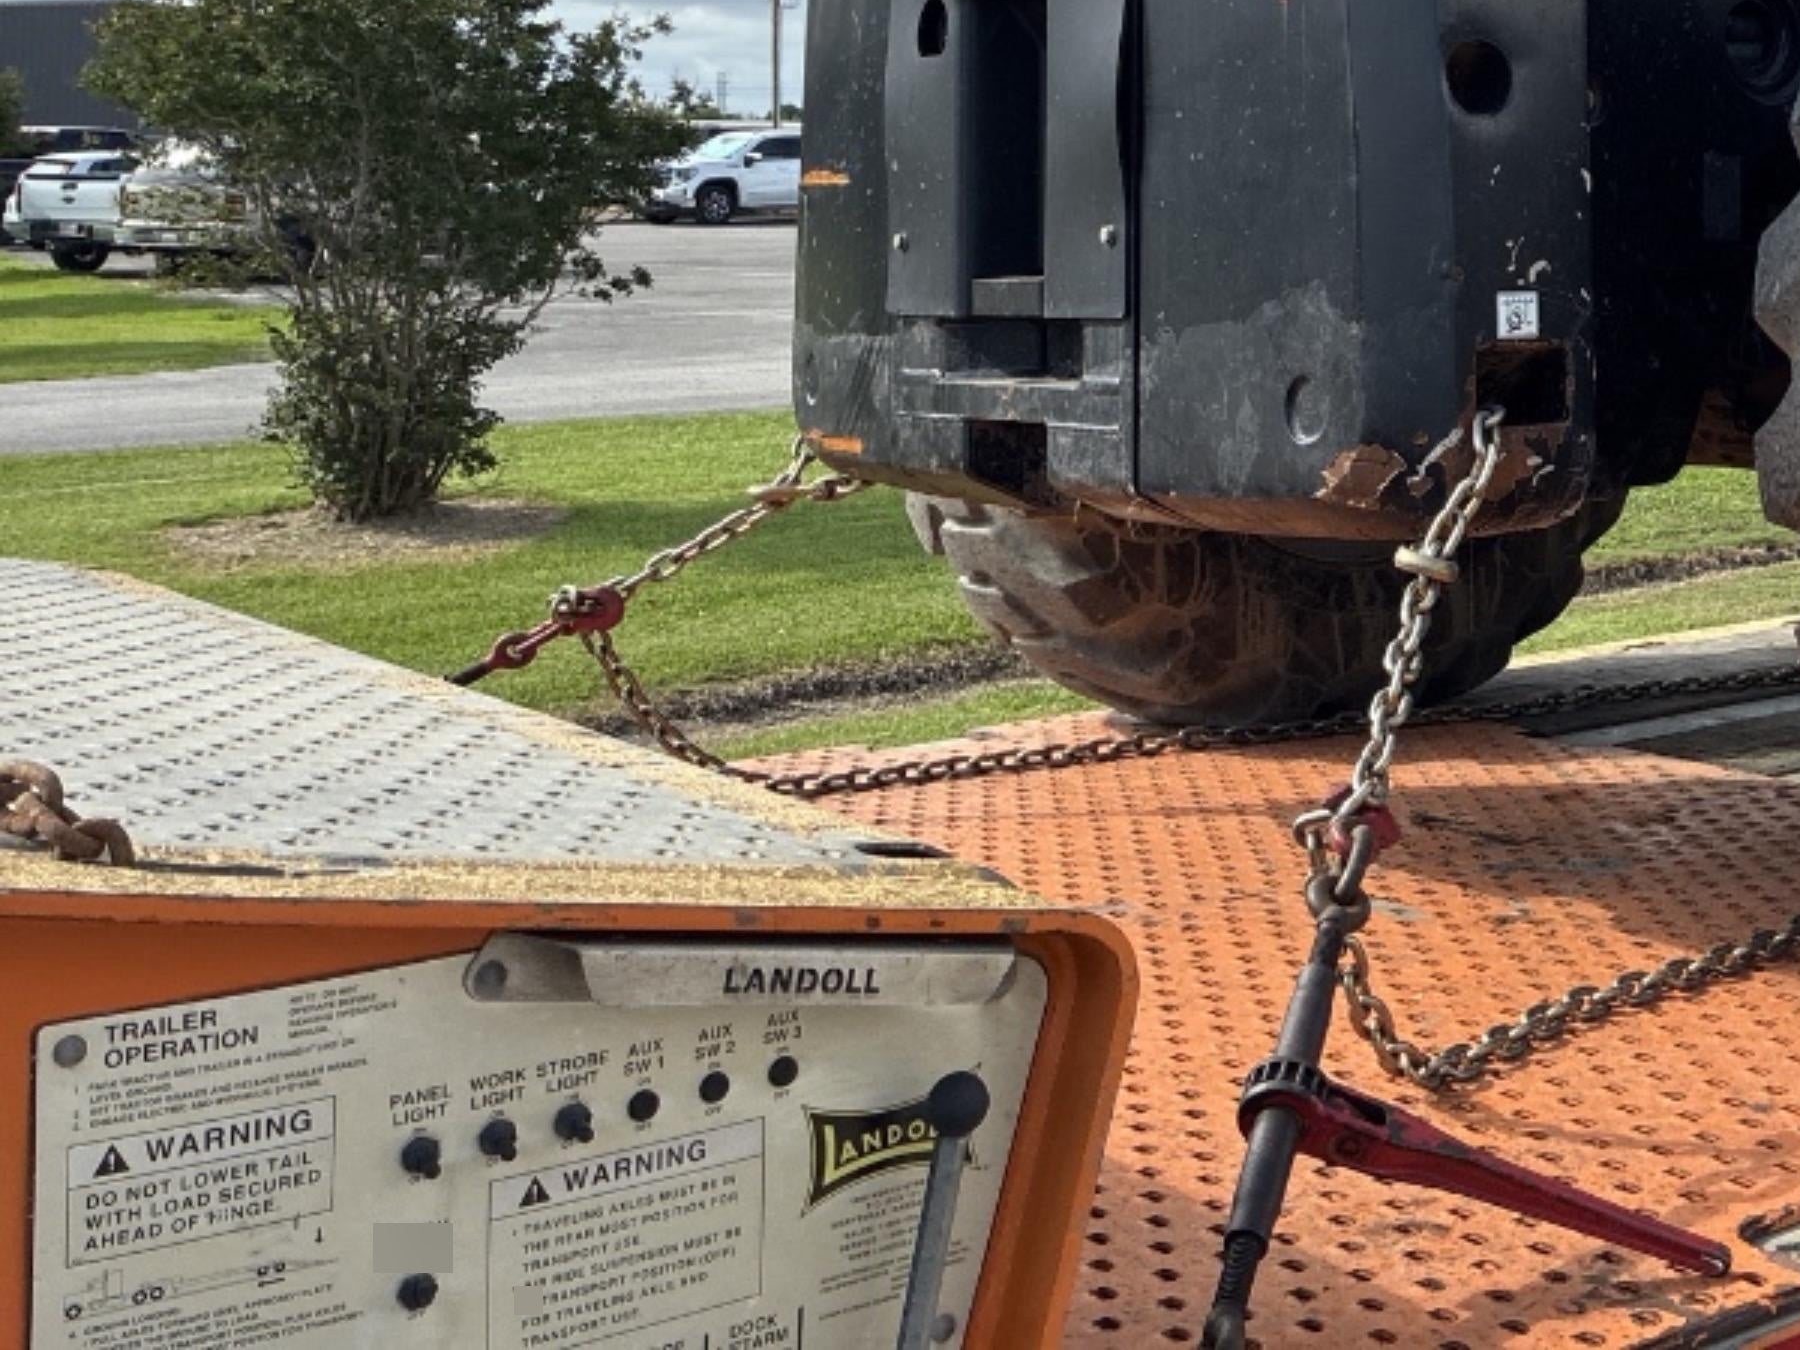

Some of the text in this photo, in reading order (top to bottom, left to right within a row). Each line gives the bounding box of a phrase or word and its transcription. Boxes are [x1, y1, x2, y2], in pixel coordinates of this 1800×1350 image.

[723, 967, 881, 995] LANDOLL
[104, 1008, 218, 1044] TRAILER
[767, 1010, 800, 1028] AUX
[698, 1023, 734, 1042] AUX
[763, 1025, 803, 1046] SW 3
[104, 1026, 259, 1069] OPERATION
[627, 1038, 664, 1059] AUX
[694, 1040, 737, 1061] SW 2
[623, 1055, 665, 1077] SW 1
[470, 1068, 527, 1092] WORK
[545, 1070, 599, 1093] LIGHT
[390, 1083, 452, 1110] PANEL
[470, 1086, 526, 1111] LIGHT
[393, 1102, 448, 1126] LIGHT
[146, 1109, 312, 1162] WARNING
[823, 1119, 940, 1185] LANDOL
[562, 1139, 708, 1192] WARNING
[86, 1151, 313, 1210] DO NOT LOWER TAIL
[85, 1168, 321, 1230] WITH LOAD SECURED
[83, 1223, 163, 1252] AHEAD
[170, 1215, 200, 1234] OF
[729, 1313, 778, 1339] DOCK
